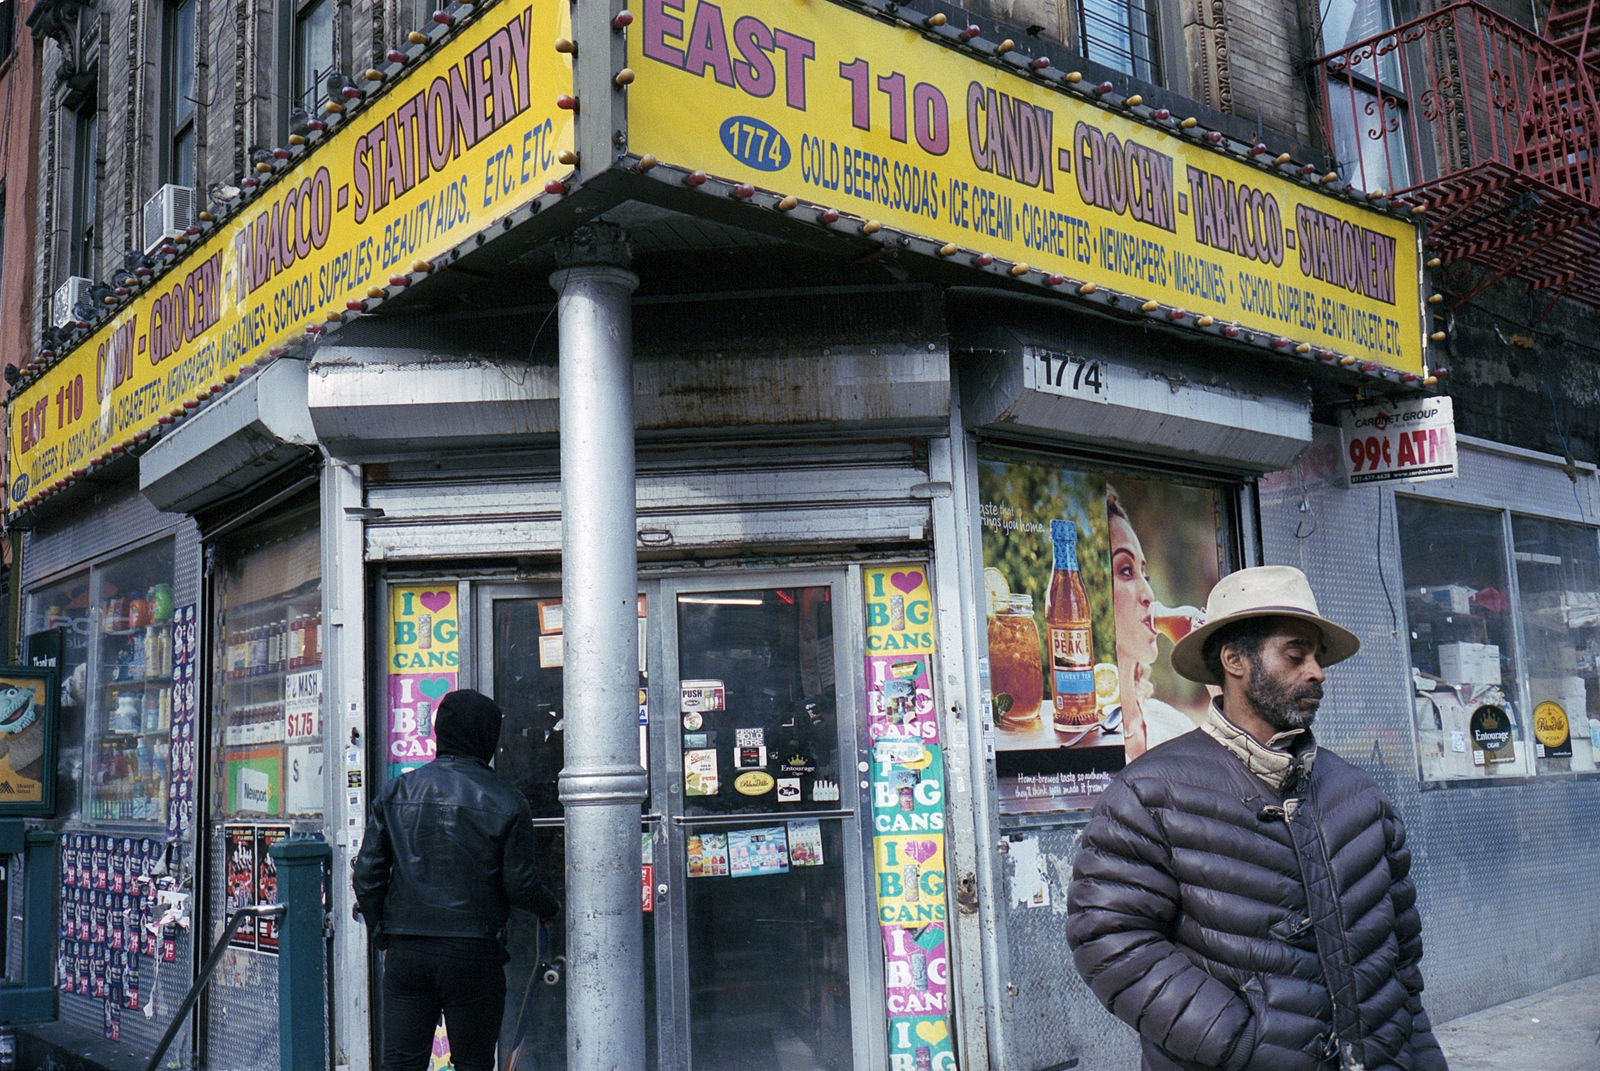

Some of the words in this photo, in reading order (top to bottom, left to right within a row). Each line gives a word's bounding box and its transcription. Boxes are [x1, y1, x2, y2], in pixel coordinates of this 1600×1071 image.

[643, 0, 815, 111] EAST
[839, 57, 950, 156] 110
[729, 121, 782, 168] 1774
[97, 314, 138, 405] CNDY
[150, 248, 223, 366] GROCERY
[235, 166, 332, 306] TABACCO
[353, 4, 532, 224] STATIONERY
[967, 81, 1054, 194] CANDY
[1073, 120, 1176, 234] GROCERY
[1186, 164, 1284, 268] TABACCO
[1295, 203, 1396, 306] STATIONERY
[801, 133, 839, 191] COLD
[949, 178, 969, 229] ICE
[972, 185, 1013, 242] CREAM
[1022, 203, 1091, 264] CIGARETTES
[1100, 226, 1166, 287] NEWSPAPERS
[1174, 250, 1226, 304] MAGAZINES
[1239, 271, 1277, 319] SCHOOL
[1278, 282, 1316, 331] SUPPLIES
[1322, 297, 1351, 341] BEAUTY
[42, 445, 58, 481] BEERS
[67, 429, 86, 466] SODAS
[119, 377, 162, 431] CIGARETTES
[166, 341, 216, 405] NEWSPAPERS
[220, 303, 266, 369] MAGAZINES
[274, 272, 315, 333] SCHOOL
[318, 236, 373, 307] SUPPLIES
[383, 195, 436, 270] BEAUTY
[1040, 356, 1102, 394] 1774
[21, 394, 49, 455] EAST
[56, 374, 84, 430] 110
[1402, 409, 1438, 422] GROUP
[1397, 427, 1450, 467] ATM
[1000, 500, 1014, 516] that
[1003, 520, 1018, 536] you
[872, 573, 885, 597] I
[401, 592, 415, 616] I
[867, 631, 933, 651] CANS
[1054, 631, 1081, 639] GOLD
[1054, 639, 1082, 654] PEAK
[393, 650, 459, 669] CANS
[298, 673, 317, 697] MASH
[400, 679, 414, 703] I
[682, 689, 703, 698] PUSH
[288, 712, 313, 738] $1.75
[869, 721, 936, 739] CANS
[1475, 730, 1509, 742] Entourage
[1060, 772, 1076, 782] taste
[1077, 773, 1084, 781] so
[244, 783, 267, 803] Newport
[1032, 784, 1048, 797] think
[1049, 786, 1061, 799] you
[1063, 782, 1079, 794] made
[1081, 783, 1086, 793] it
[1087, 781, 1103, 796] from
[875, 812, 943, 833] CANS
[884, 841, 899, 866] I
[880, 904, 945, 922] CANS
[891, 929, 908, 956] I
[895, 1022, 912, 1048] I
